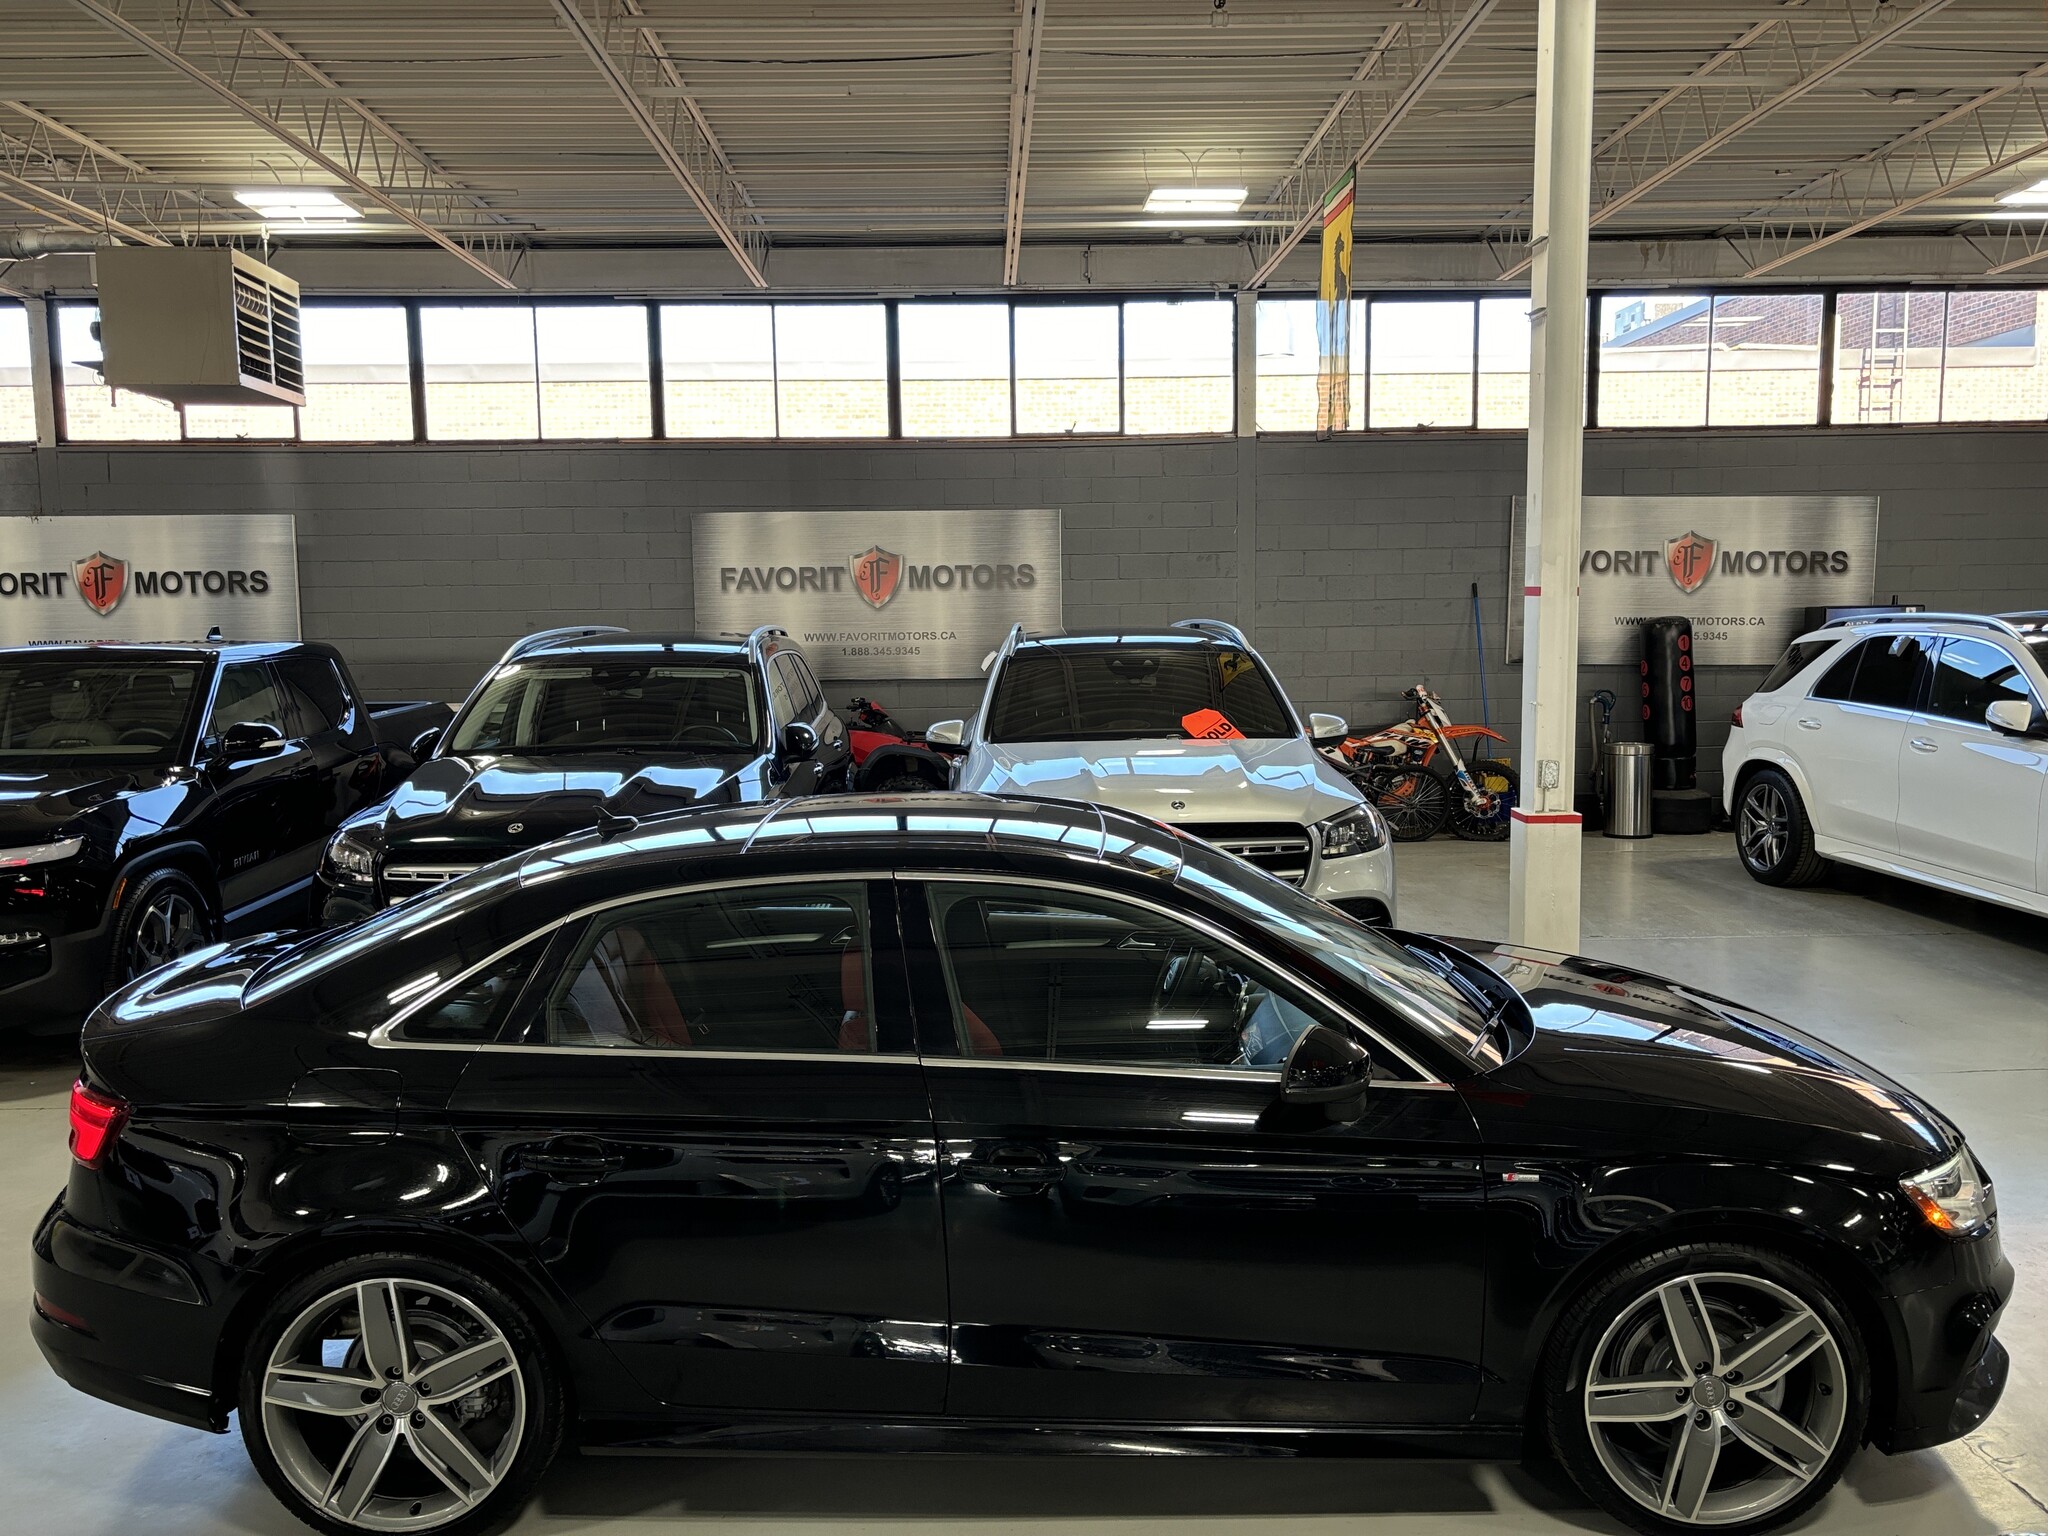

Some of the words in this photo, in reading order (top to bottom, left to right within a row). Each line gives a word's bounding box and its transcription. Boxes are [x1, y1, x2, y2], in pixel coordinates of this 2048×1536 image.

[1721, 550, 1849, 574] MOTORS
[0, 572, 68, 596] ORIT
[134, 570, 269, 595] MOTORS
[720, 566, 844, 591] FAVORIT
[908, 563, 1035, 590] MOTORS
[804, 631, 957, 642] WWW.FAVORITMOTORS.CA
[1693, 631, 1728, 641] 5.9345
[841, 646, 921, 656] 1.888.345.9345
[1200, 722, 1232, 739] OLD
